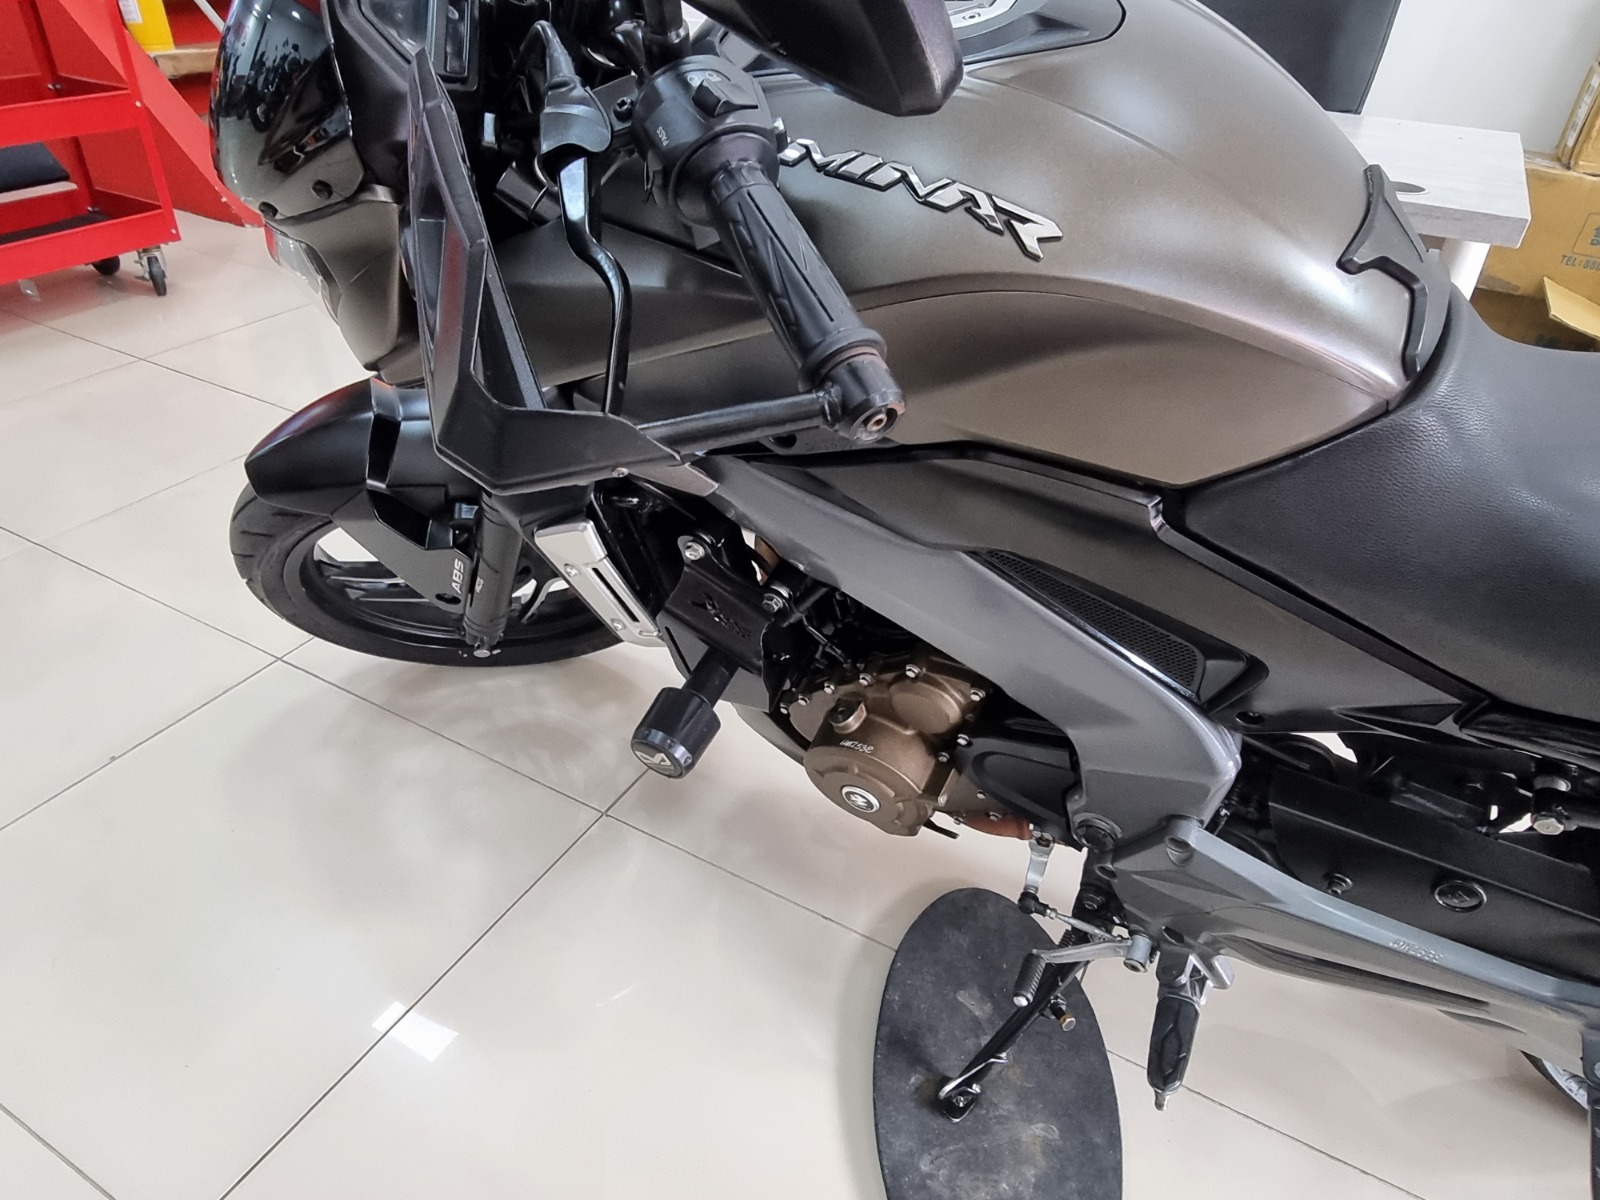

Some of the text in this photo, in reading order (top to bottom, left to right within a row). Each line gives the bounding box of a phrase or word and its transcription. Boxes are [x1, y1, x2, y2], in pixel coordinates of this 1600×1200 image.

[656, 126, 670, 147] PASS
[779, 137, 1064, 262] MINAR
[451, 557, 464, 595] ABS
